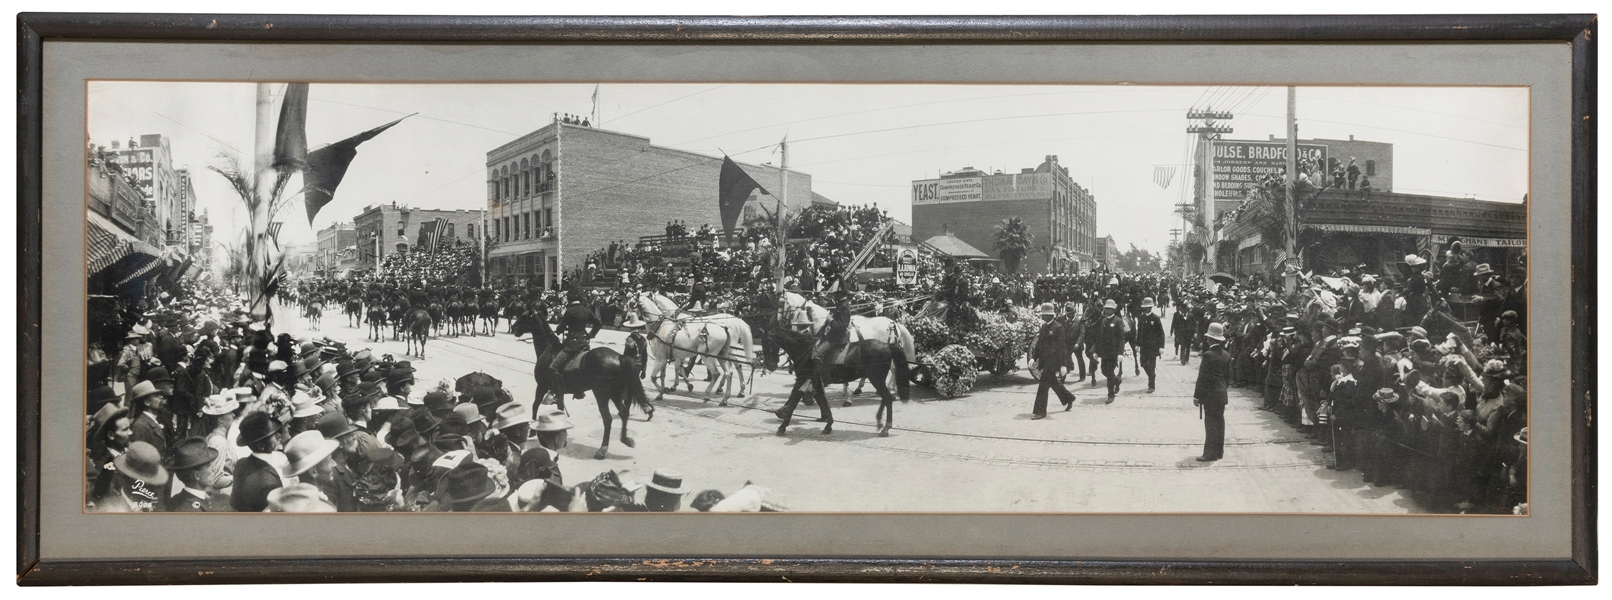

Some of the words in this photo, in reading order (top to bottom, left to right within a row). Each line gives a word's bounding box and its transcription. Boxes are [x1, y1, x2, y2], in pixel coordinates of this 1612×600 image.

[1248, 146, 1302, 160] BRADFOD
[1213, 165, 1232, 173] ARLOR
[913, 183, 939, 201] YEAST.
[1438, 236, 1488, 245] MCHANT
